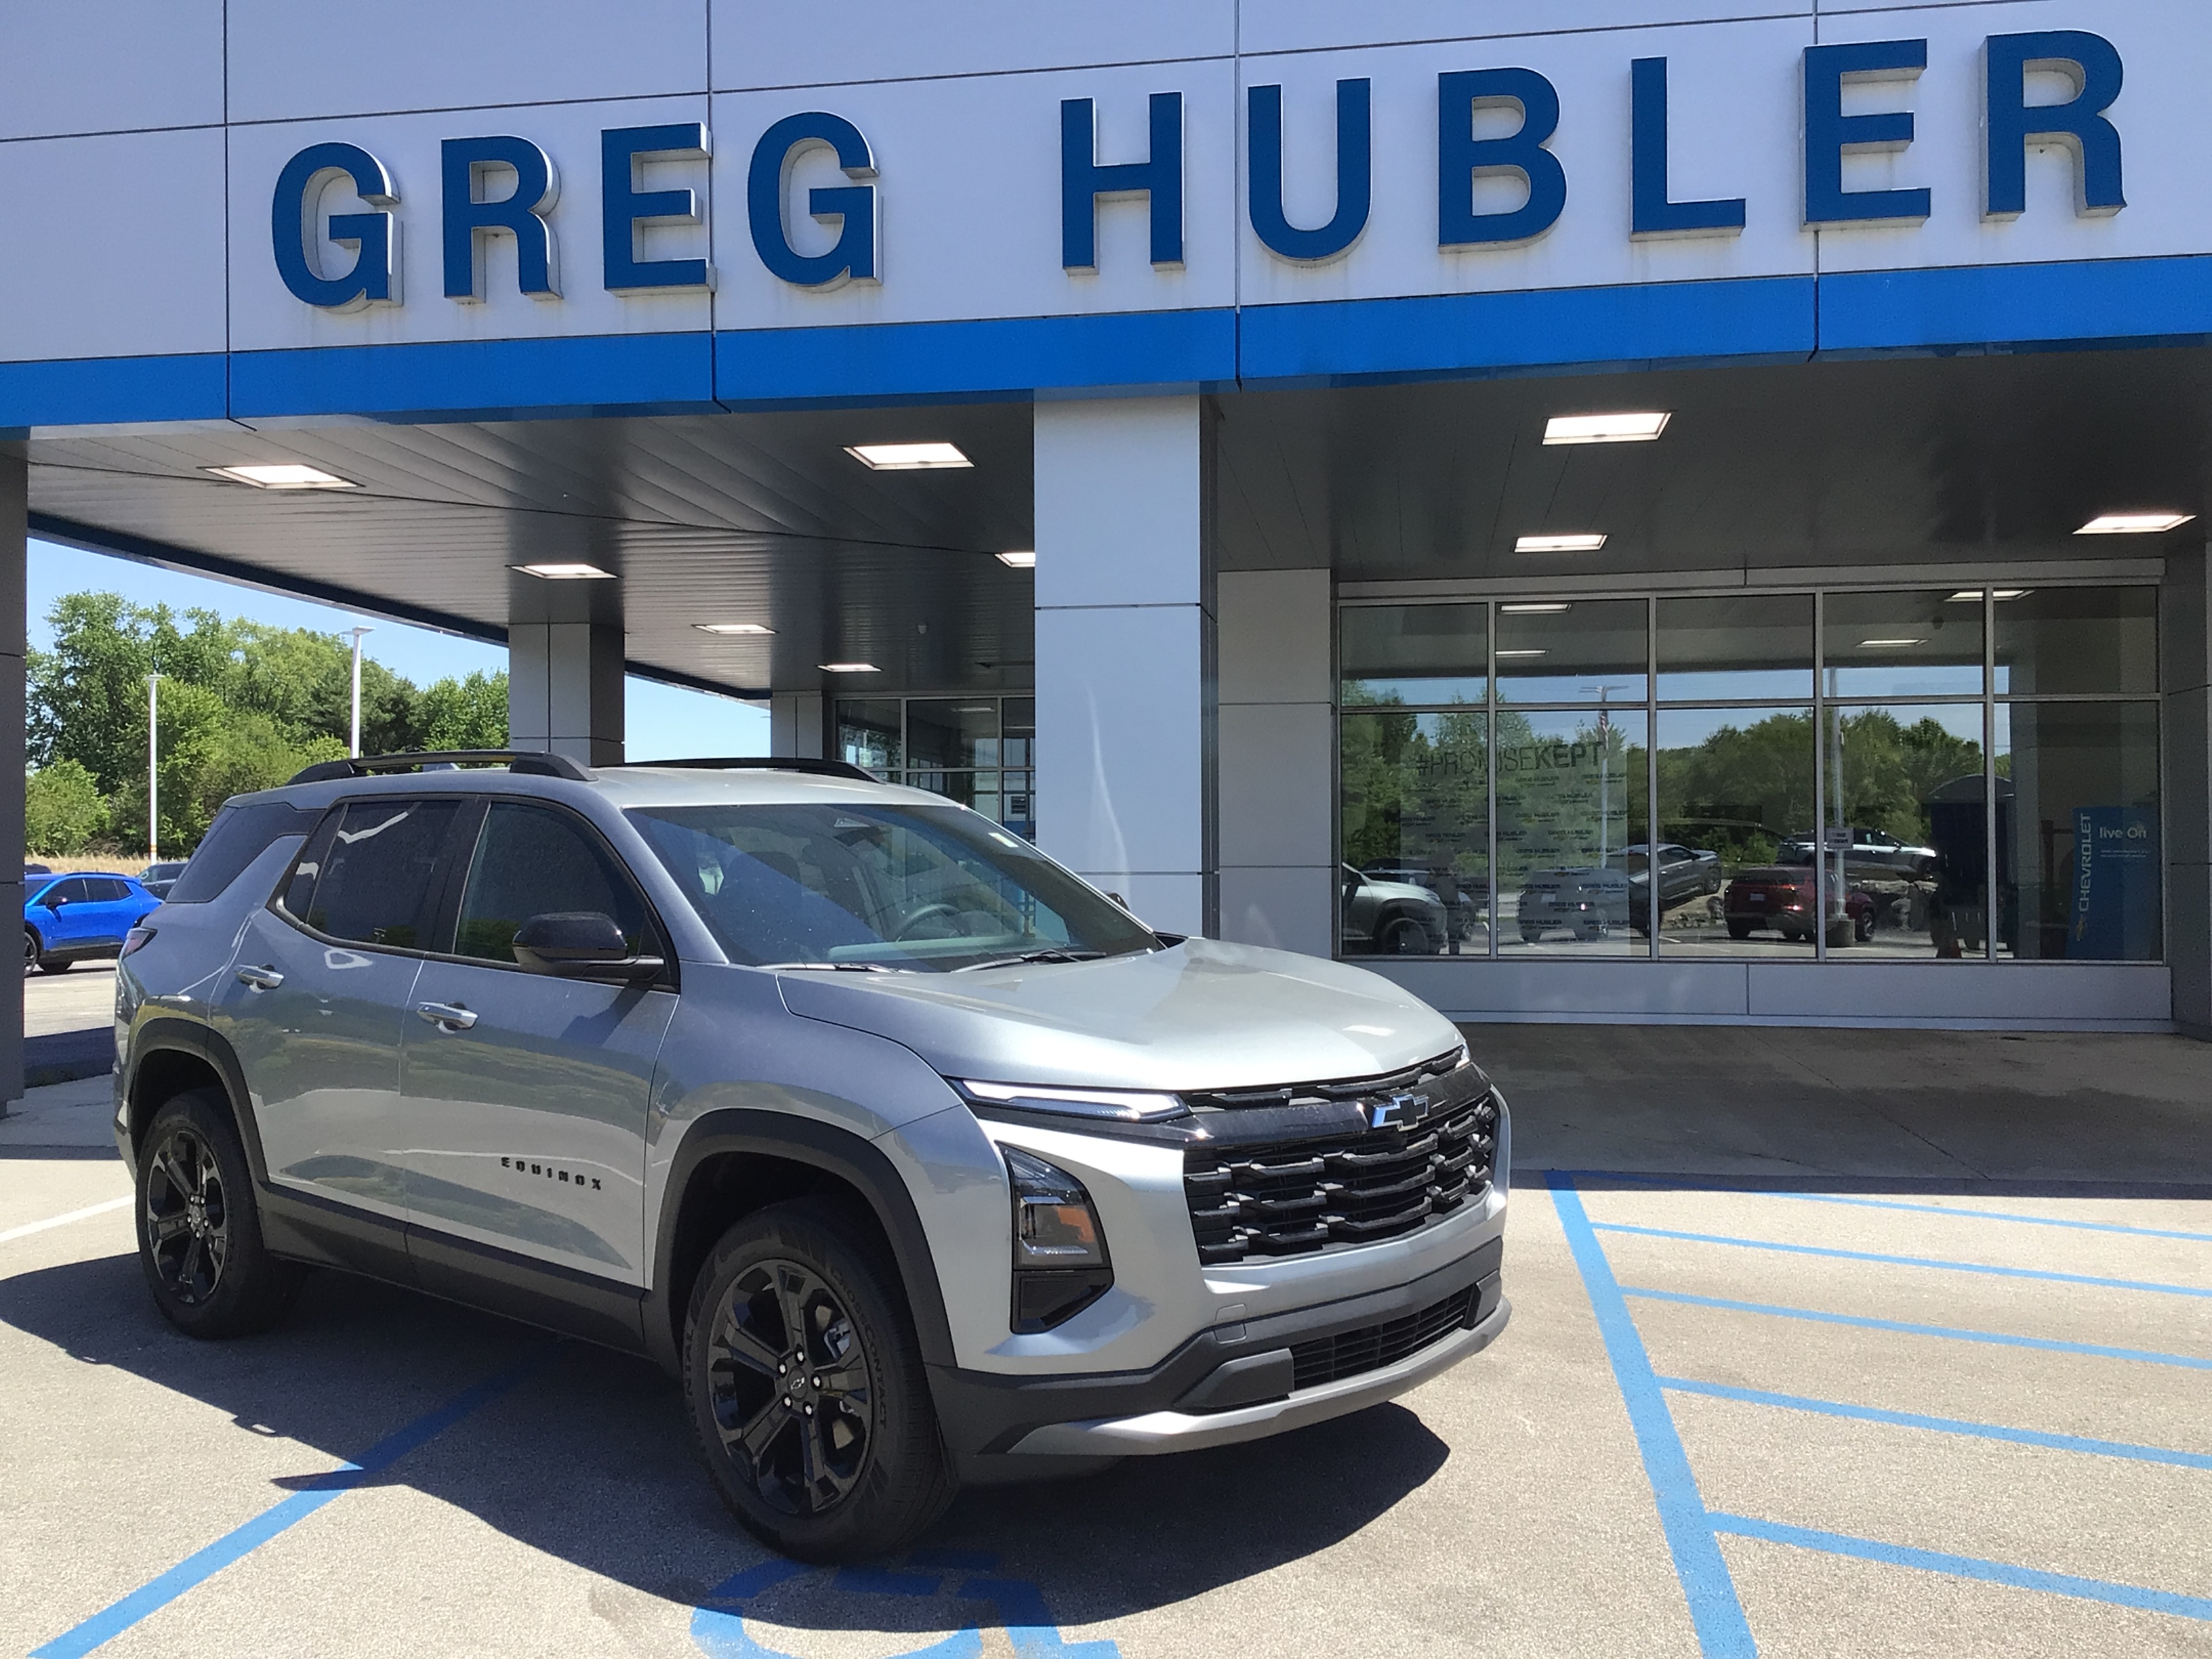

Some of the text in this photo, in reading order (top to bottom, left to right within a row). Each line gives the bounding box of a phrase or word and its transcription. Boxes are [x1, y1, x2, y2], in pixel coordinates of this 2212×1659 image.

[271, 28, 2127, 314] GREG HUBLER
[2078, 813, 2092, 912] CHEVROLET
[2099, 827, 2147, 839] live On
[501, 1156, 601, 1190] EQUINOX
